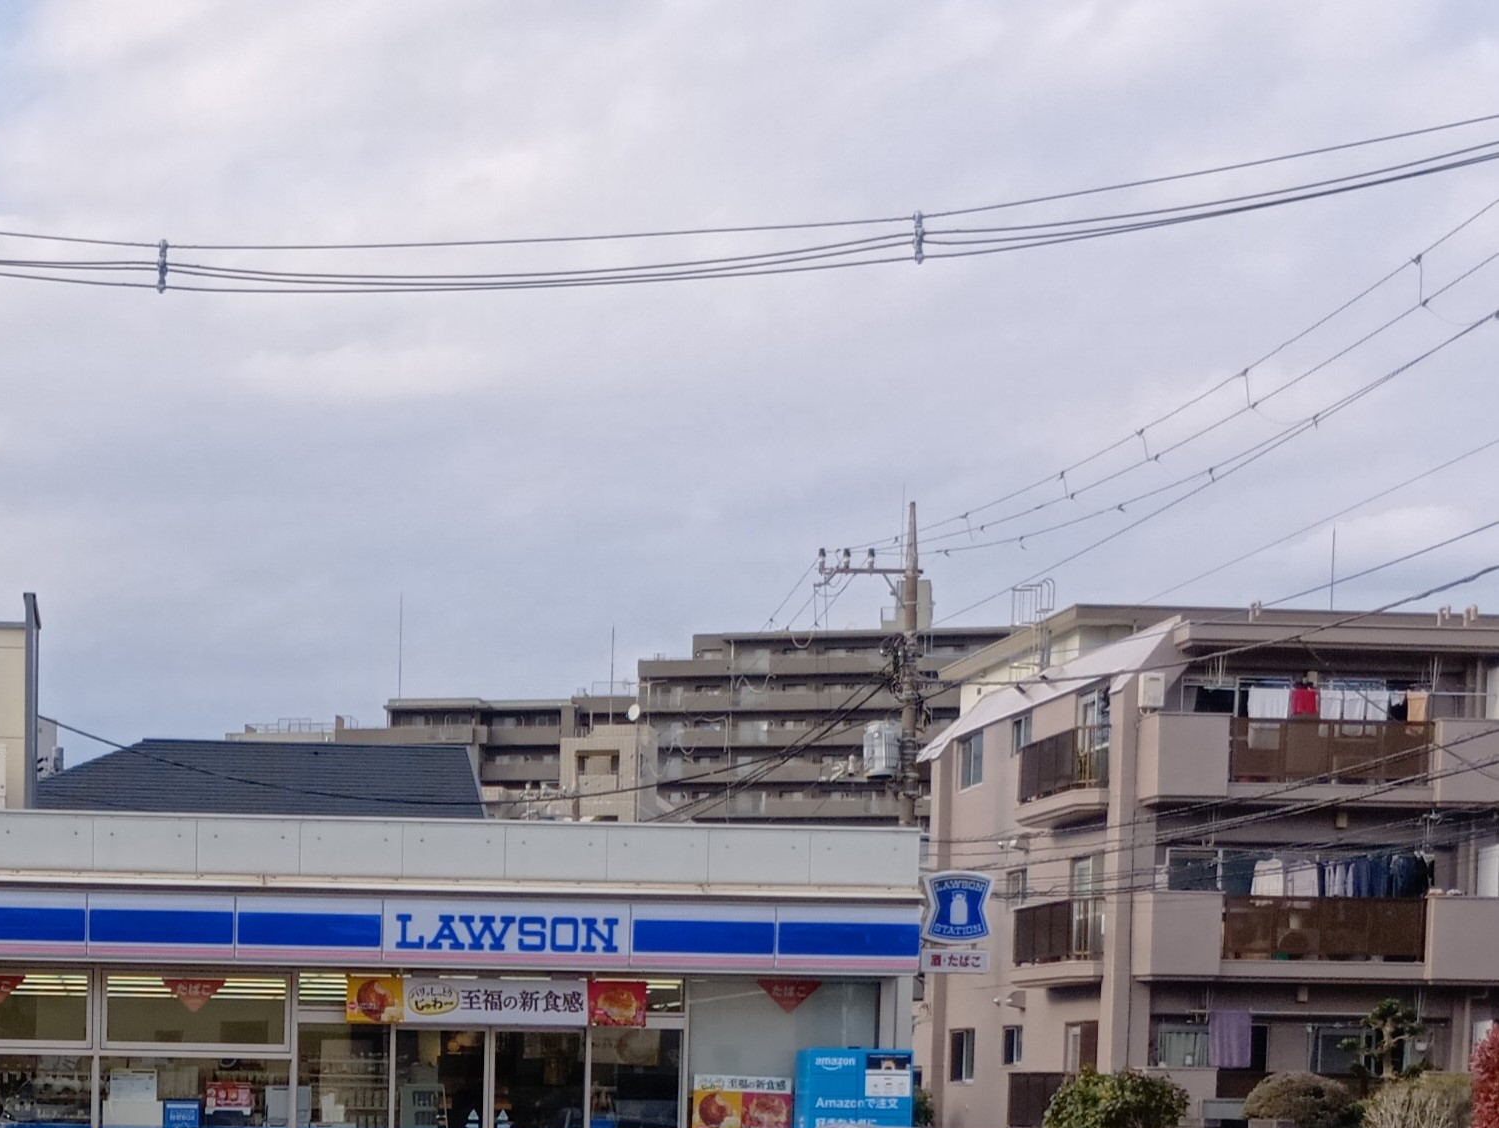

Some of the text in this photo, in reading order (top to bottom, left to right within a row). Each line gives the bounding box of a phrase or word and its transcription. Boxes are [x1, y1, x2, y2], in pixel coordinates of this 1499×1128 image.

[934, 880, 984, 892] LAWSON
[395, 914, 619, 953] LAWSON
[933, 923, 982, 936] STATION
[176, 983, 211, 996] たばこ
[772, 985, 807, 997] たばこ
[460, 989, 584, 1013] 至福の新食感
[815, 1057, 856, 1069] amazon
[728, 1077, 787, 1091] 至福の新食感
[815, 1097, 898, 1110] Amazonで注文
